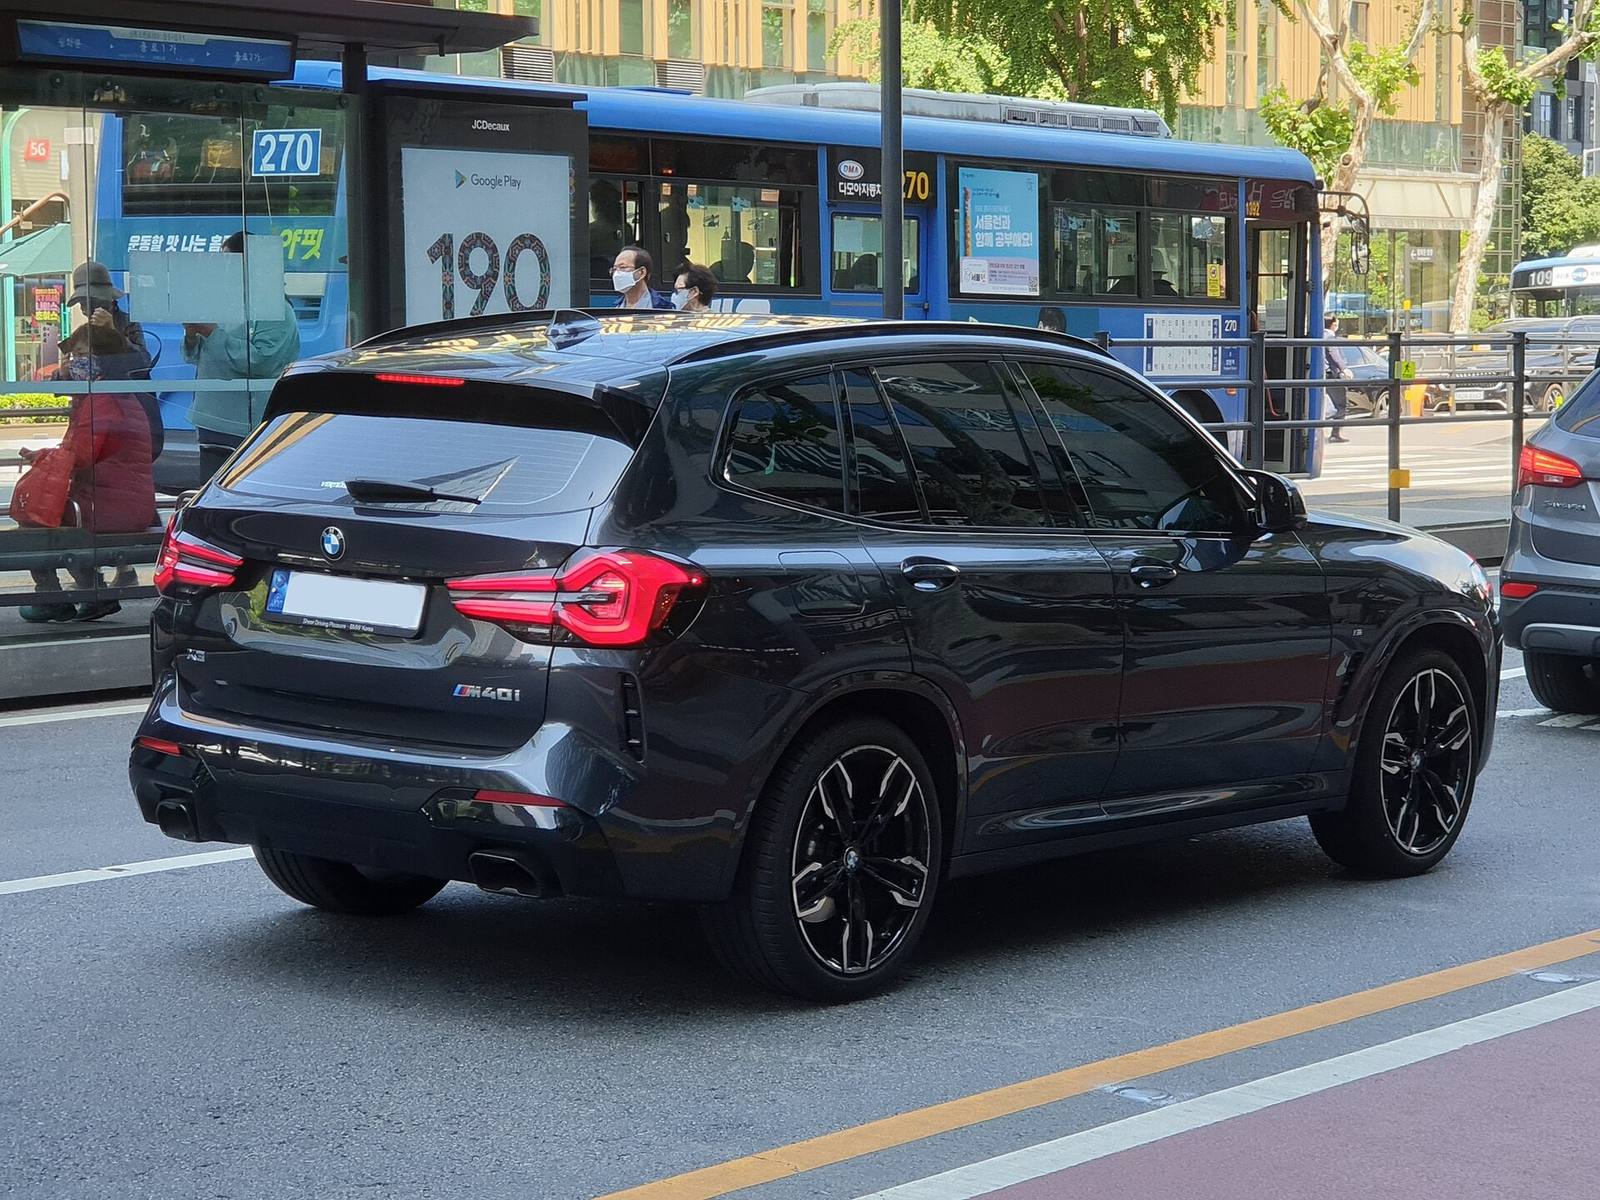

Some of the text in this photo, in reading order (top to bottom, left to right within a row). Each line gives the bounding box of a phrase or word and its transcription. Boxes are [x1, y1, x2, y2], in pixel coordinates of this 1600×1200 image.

[471, 119, 511, 132] JCDecaux
[31, 142, 46, 156] 5G
[258, 133, 314, 173] 270
[843, 164, 859, 174] DMA
[470, 173, 521, 190] Google Play
[975, 214, 1010, 230] 서울런과
[128, 234, 163, 253] 운동할
[165, 235, 179, 253] 맛
[181, 235, 206, 253] 나는
[279, 228, 324, 260] 야핏
[975, 231, 993, 248] 함께
[426, 231, 551, 320] 190
[1529, 270, 1552, 286] 109
[1224, 319, 1238, 332] 270
[454, 684, 521, 702] M40i
